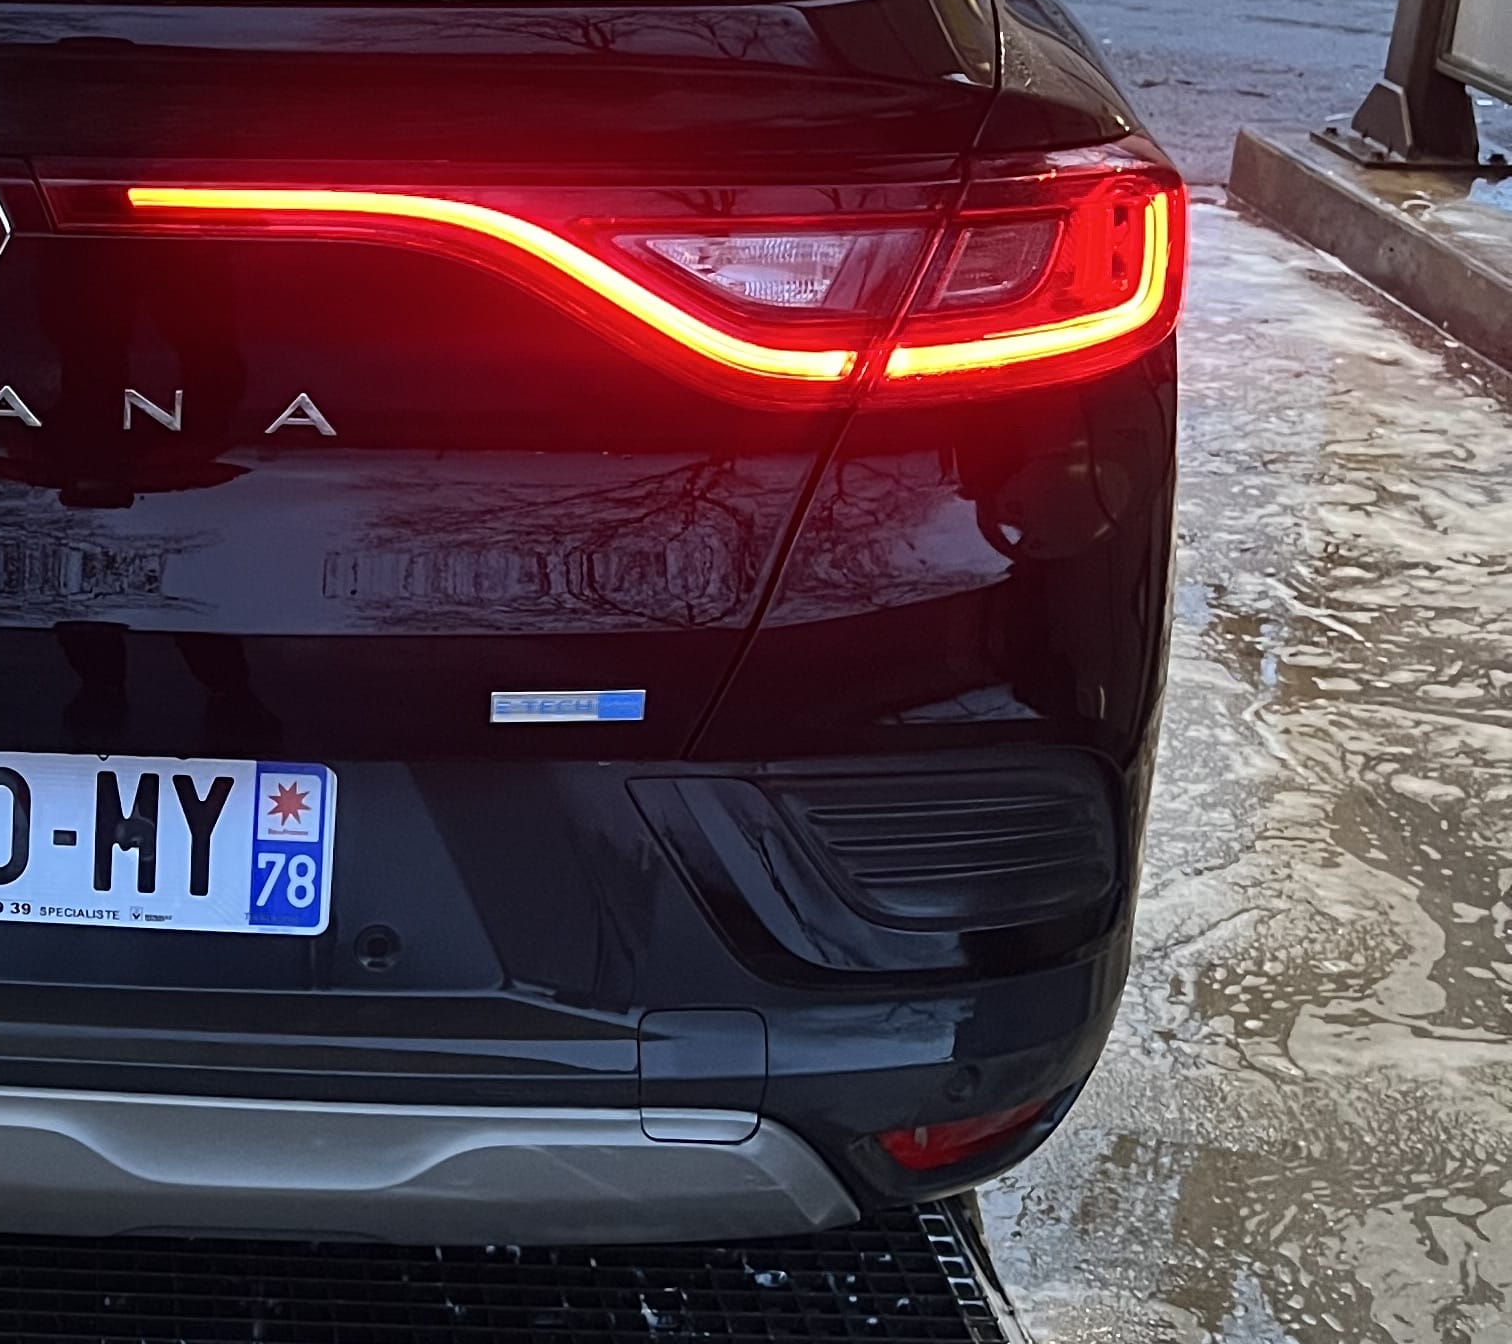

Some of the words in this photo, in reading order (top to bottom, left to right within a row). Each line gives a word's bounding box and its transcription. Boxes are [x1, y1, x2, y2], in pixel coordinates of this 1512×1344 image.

[255, 852, 317, 909] 78
[10, 902, 31, 915] 39
[39, 906, 120, 921] SPECIALISTE
